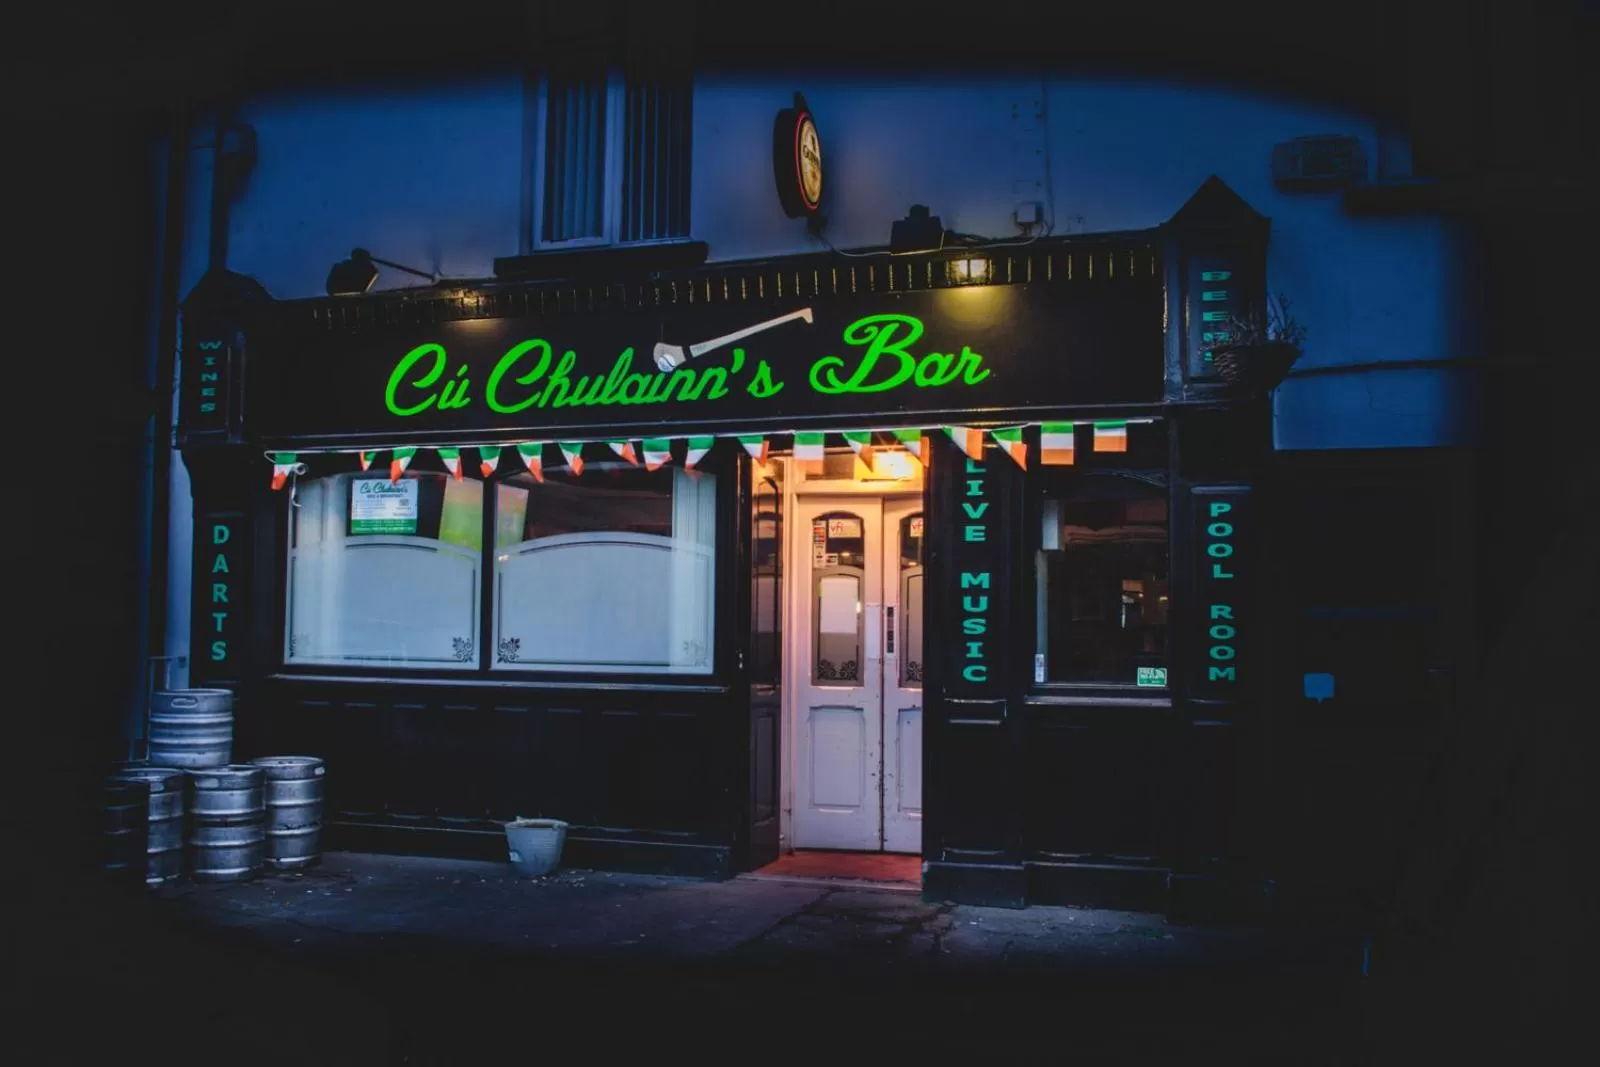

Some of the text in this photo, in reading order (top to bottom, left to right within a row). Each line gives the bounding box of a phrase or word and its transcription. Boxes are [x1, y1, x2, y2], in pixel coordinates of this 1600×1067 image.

[200, 341, 222, 412] WINES
[385, 313, 990, 416] Cú Chulainn's Bar
[211, 524, 230, 661] DARTS
[960, 458, 991, 683] LIVE MUSIC
[1206, 501, 1236, 681] POOL ROOM
